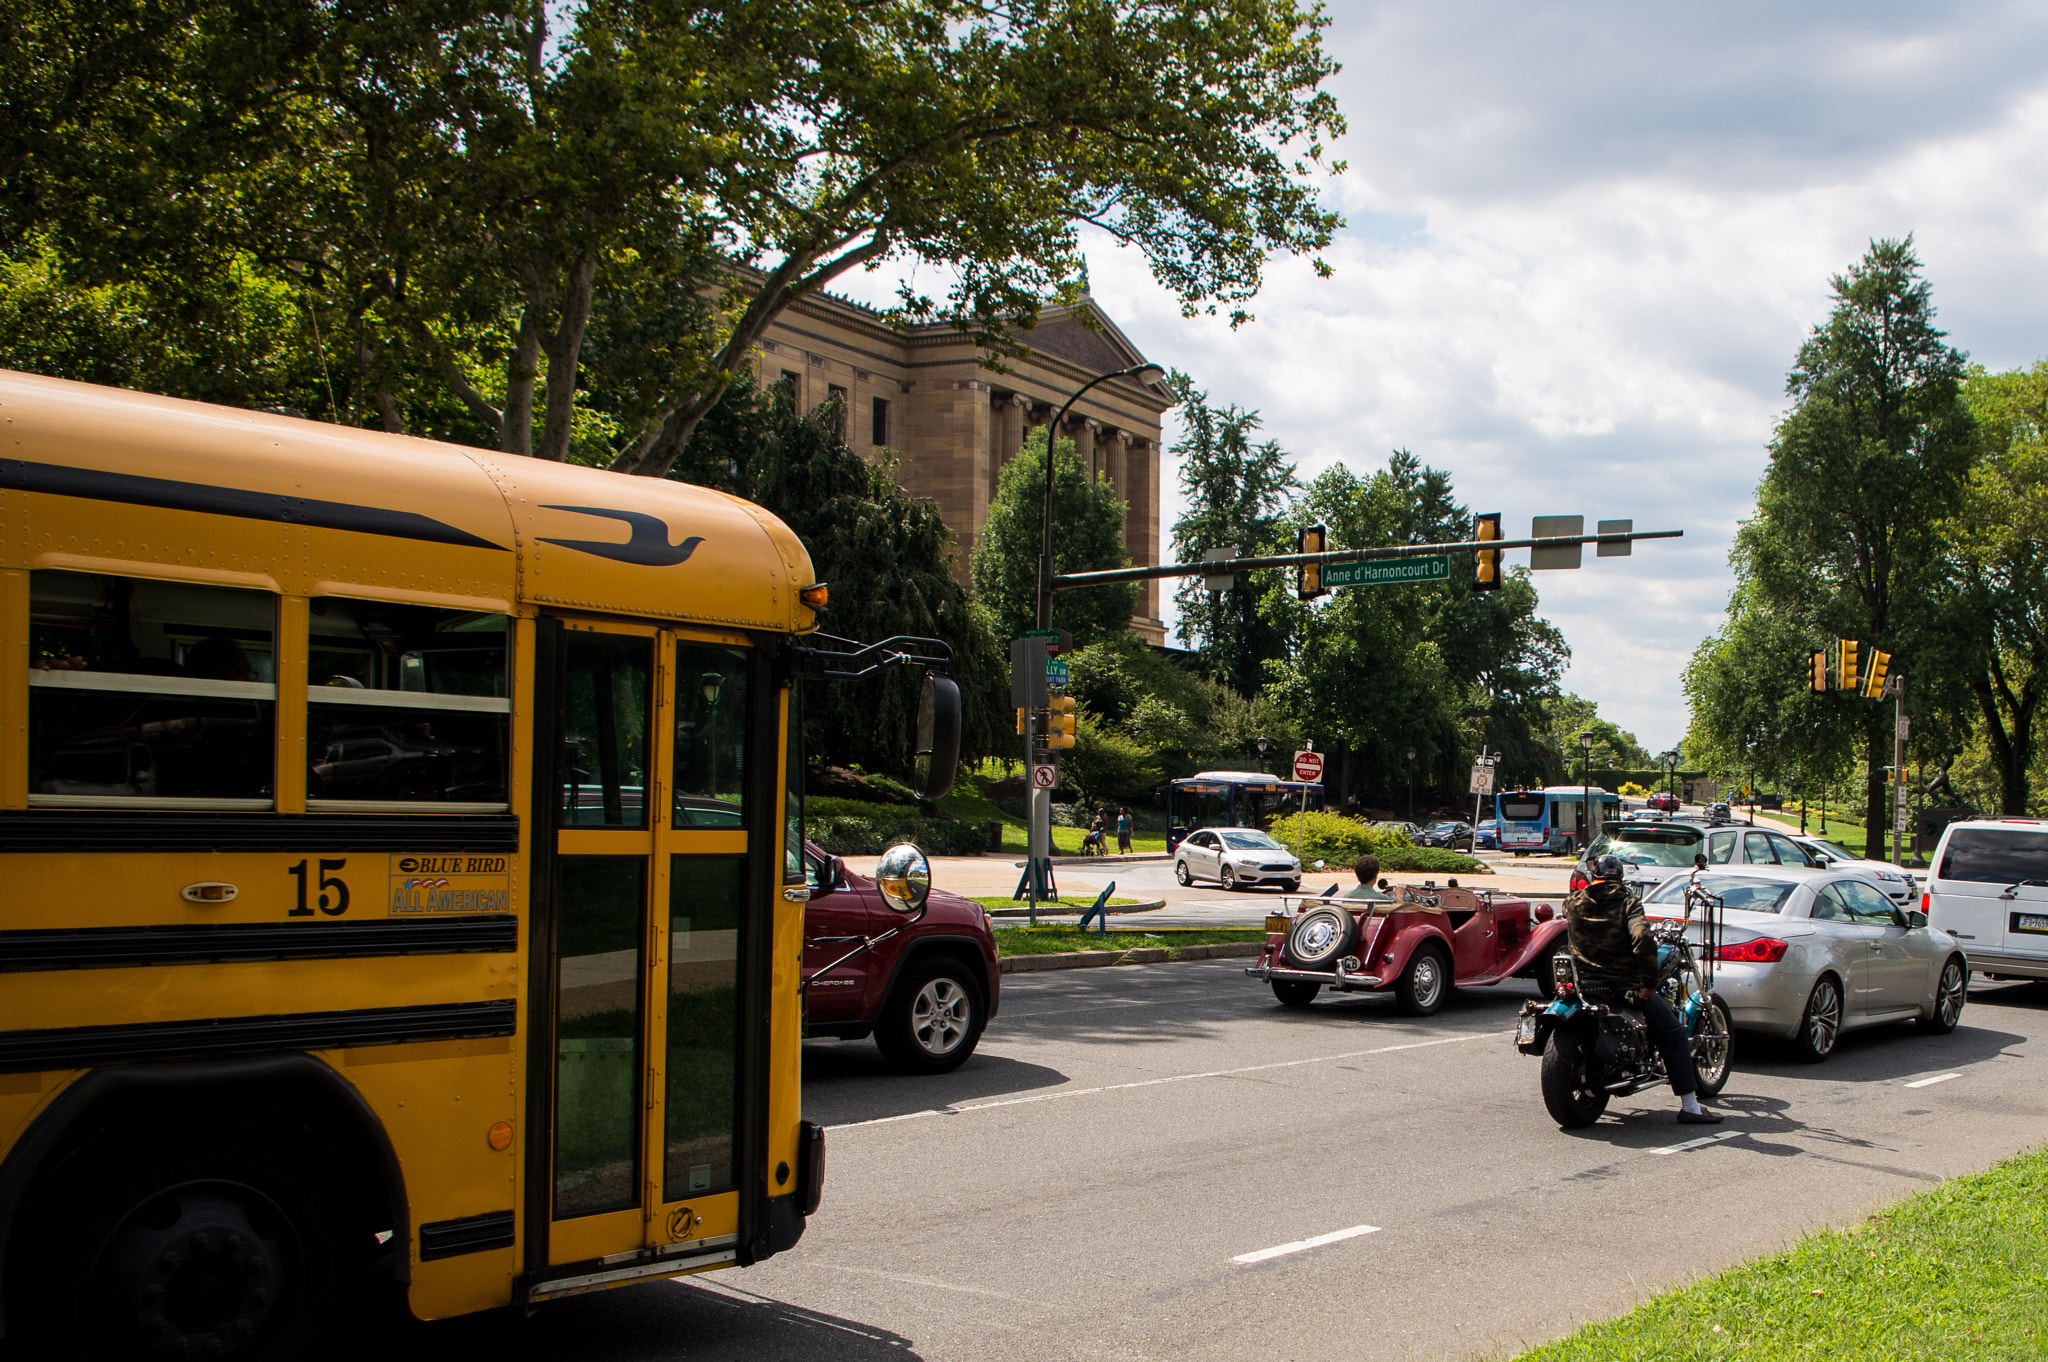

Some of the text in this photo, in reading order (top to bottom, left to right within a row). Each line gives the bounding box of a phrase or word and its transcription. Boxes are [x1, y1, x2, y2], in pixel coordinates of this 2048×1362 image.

[1325, 561, 1445, 583] Anne d'Harnoncourt Dr
[1046, 665, 1058, 675] LLY
[419, 857, 505, 873] BLUE BIRD
[288, 858, 350, 917] 15
[393, 887, 507, 912] ALL AMERICAN
[1344, 957, 1358, 970] GB
